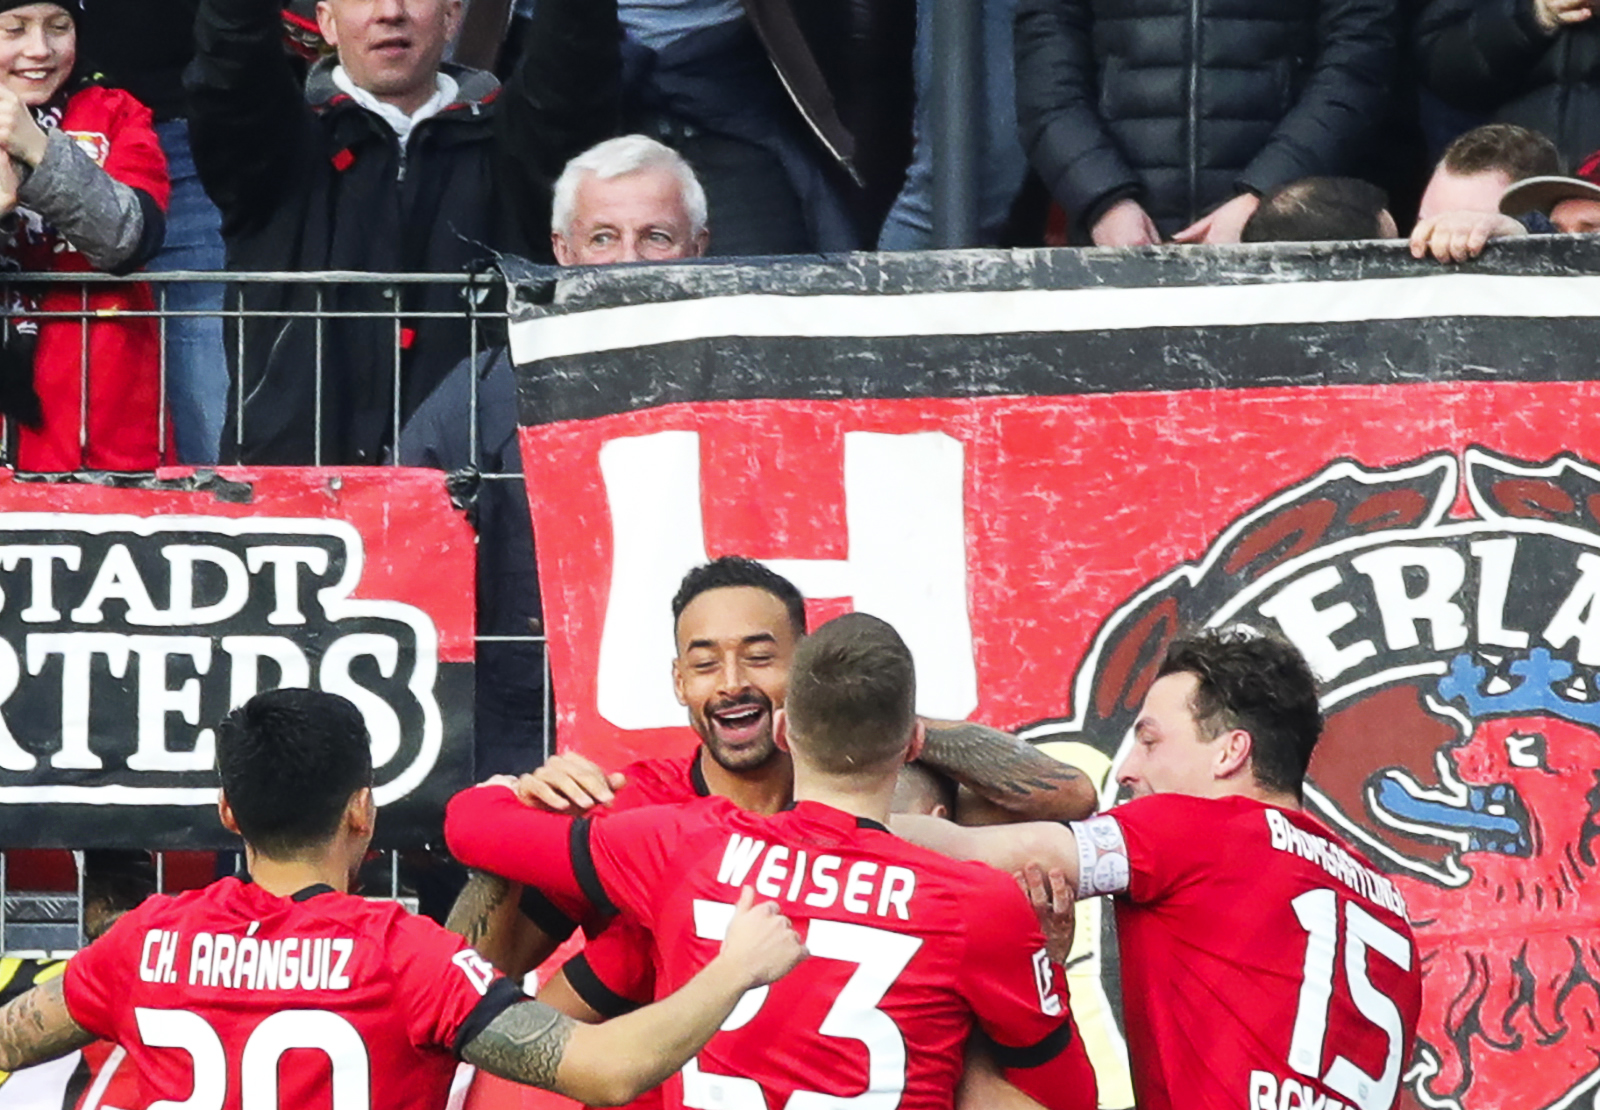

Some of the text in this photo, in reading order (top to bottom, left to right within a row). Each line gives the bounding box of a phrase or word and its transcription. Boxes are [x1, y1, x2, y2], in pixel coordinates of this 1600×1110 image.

[716, 833, 916, 920] WEISER
[139, 921, 354, 991] CH. ARÁNGUIZ
